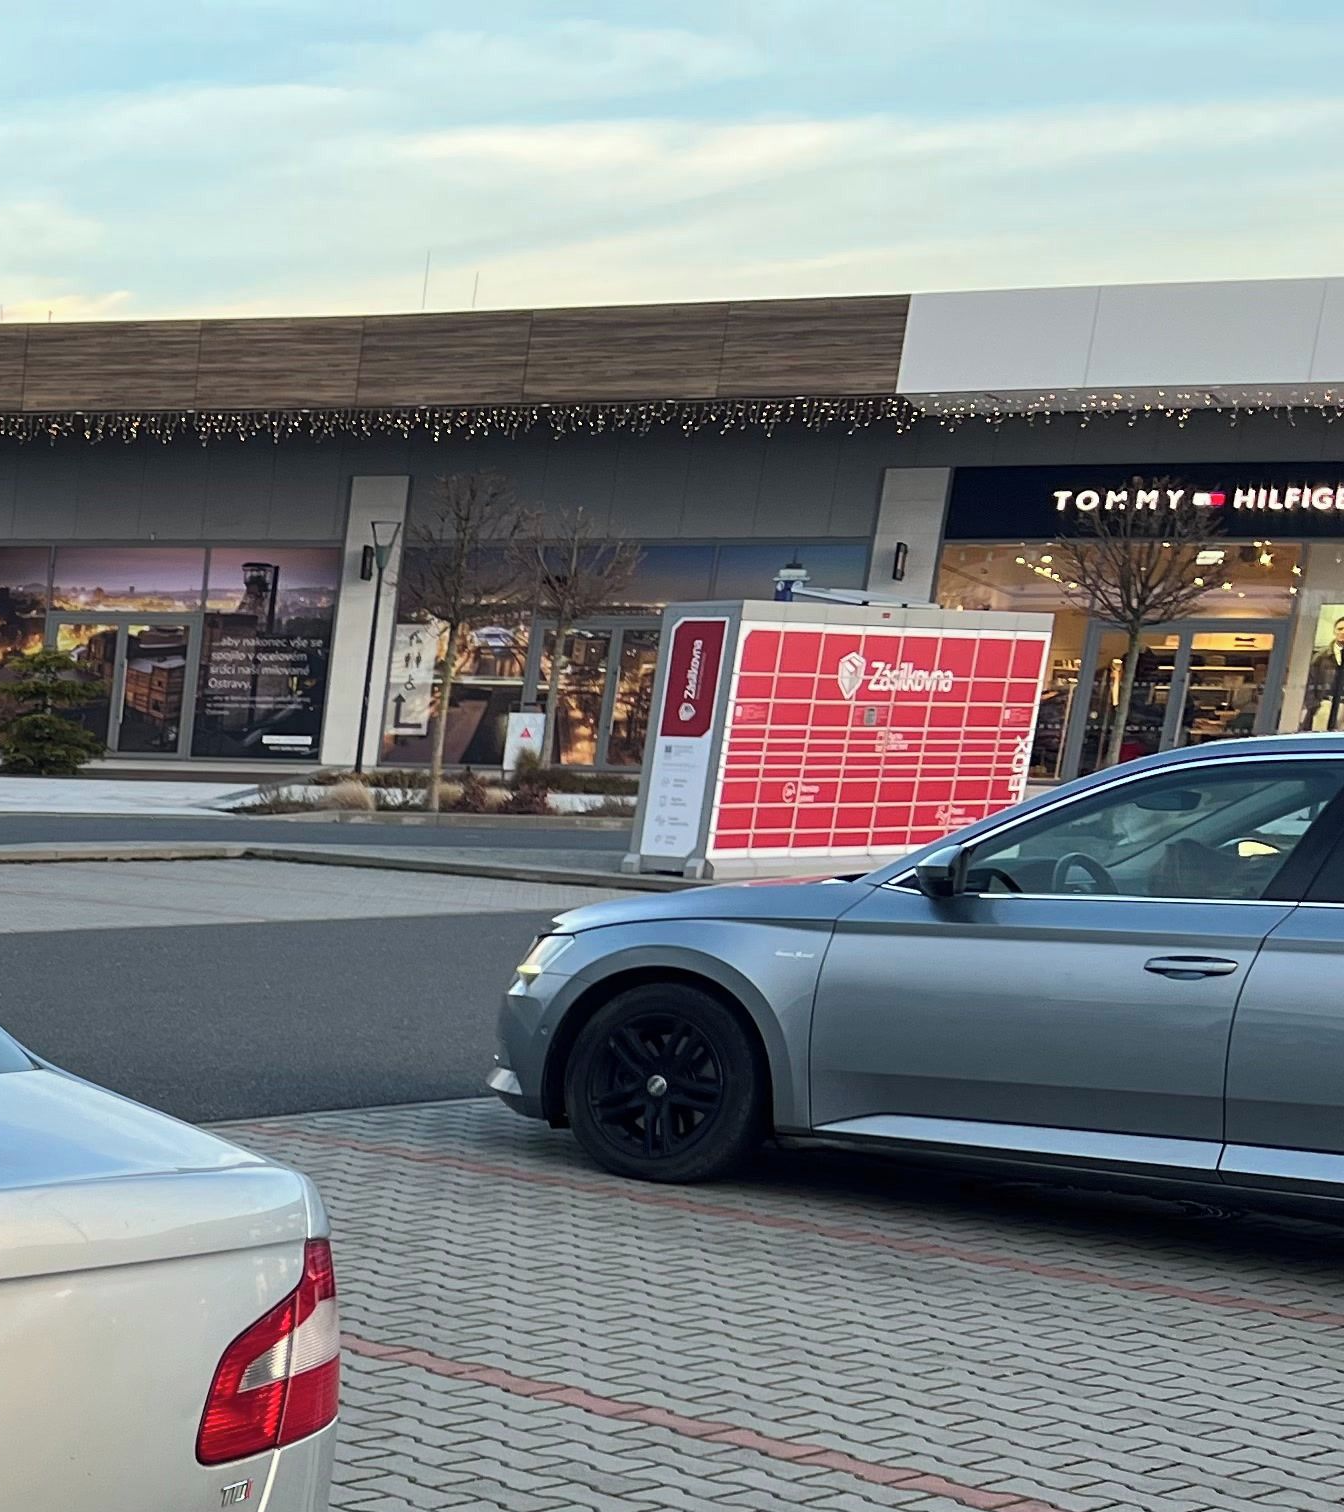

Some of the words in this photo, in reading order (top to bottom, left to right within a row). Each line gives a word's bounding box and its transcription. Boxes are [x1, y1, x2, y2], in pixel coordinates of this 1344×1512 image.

[1053, 489, 1185, 511] TOMMY
[868, 661, 954, 692] Zásilkovna
[1006, 735, 1031, 807] -BOX
